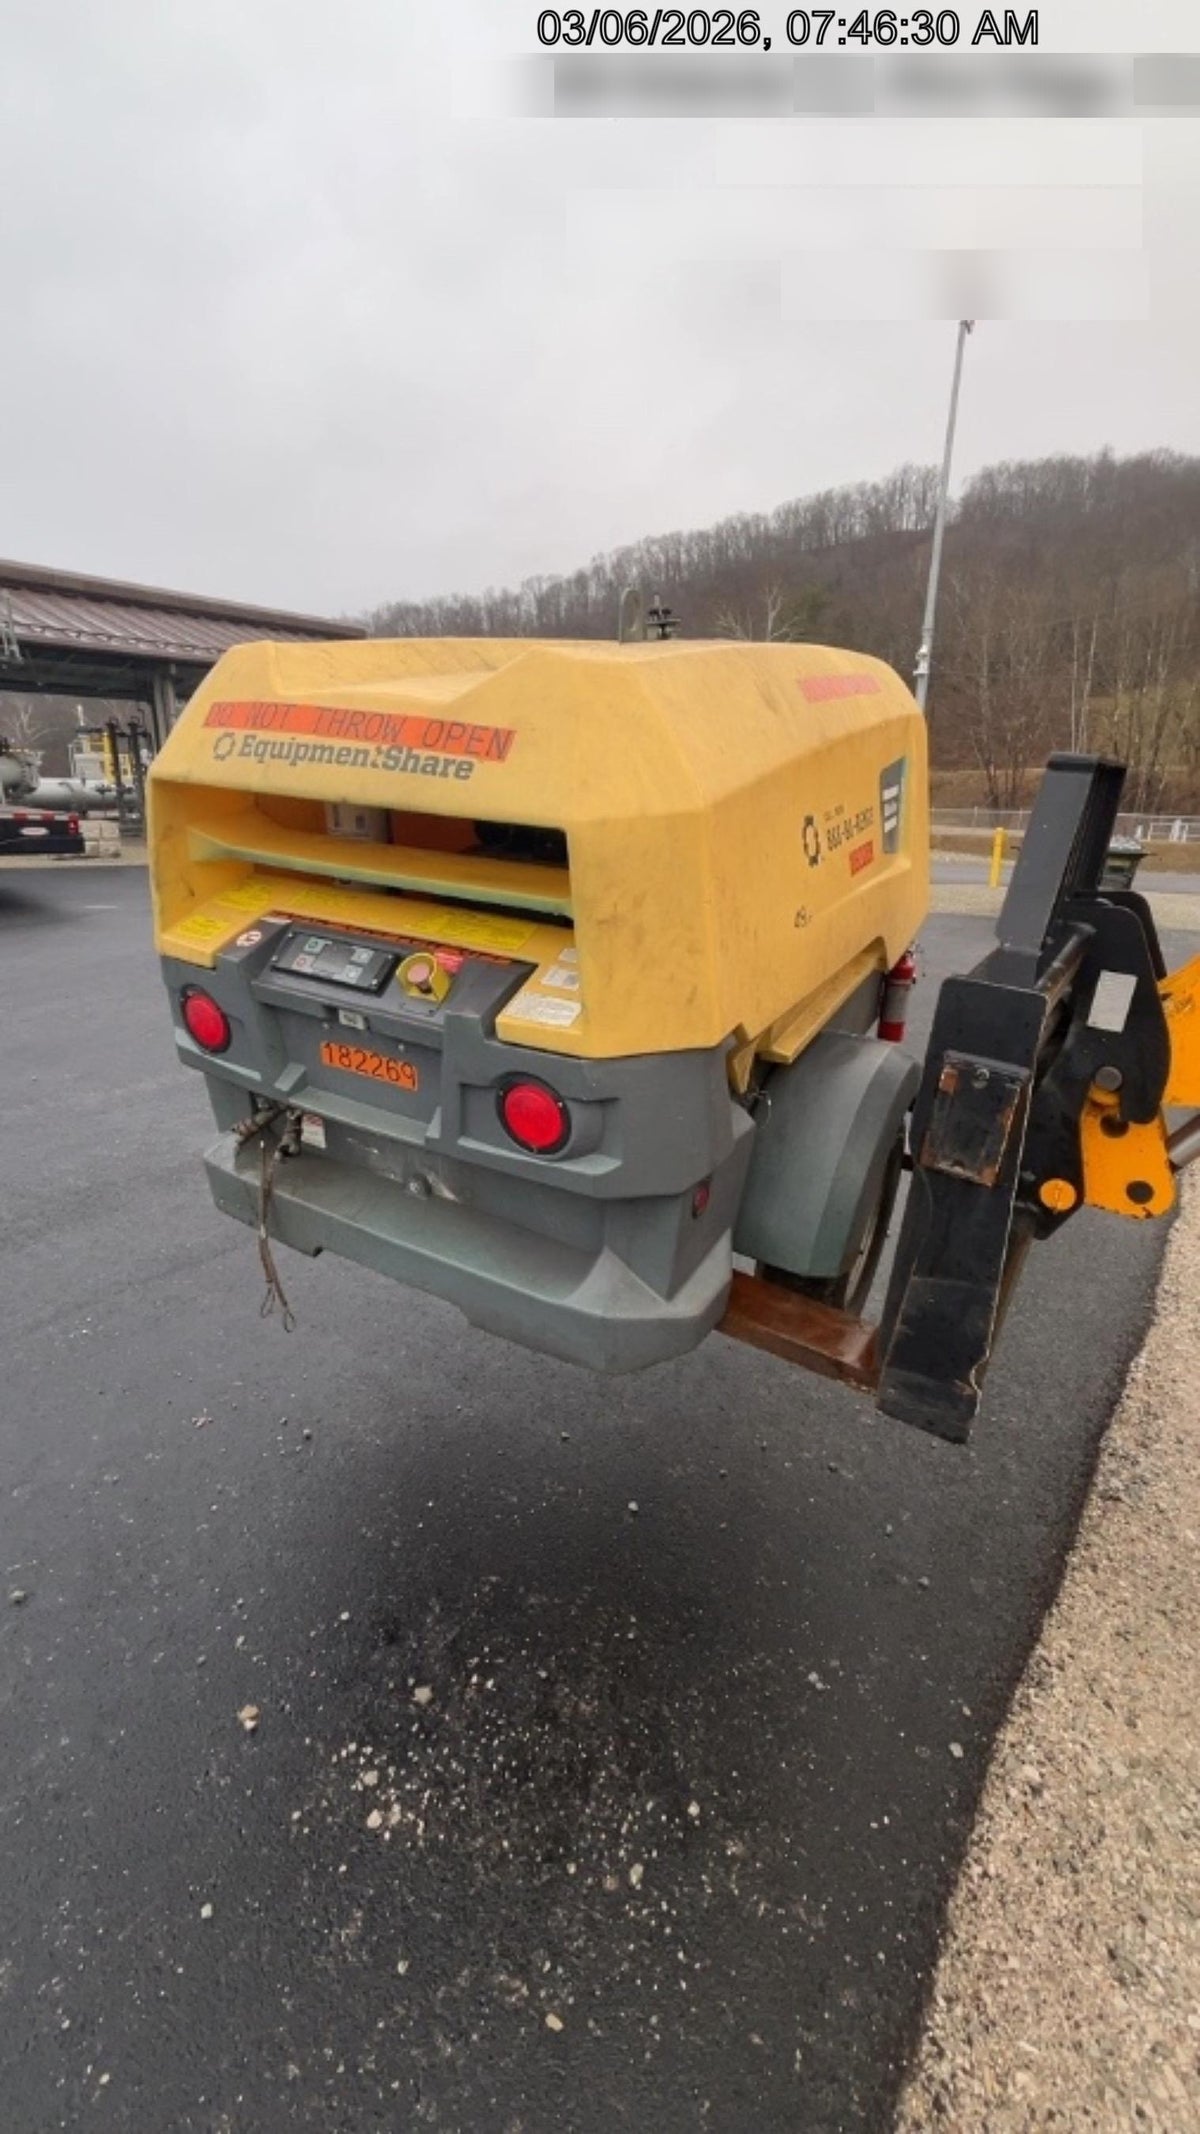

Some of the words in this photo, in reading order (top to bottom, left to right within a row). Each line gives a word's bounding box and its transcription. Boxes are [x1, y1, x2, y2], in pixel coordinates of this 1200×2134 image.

[205, 702, 234, 727] DO
[247, 702, 297, 729] NOT
[311, 707, 408, 743] THROW
[421, 719, 514, 760] OPEN
[237, 734, 476, 780] EquipmentShare
[323, 1042, 416, 1088] 182269
